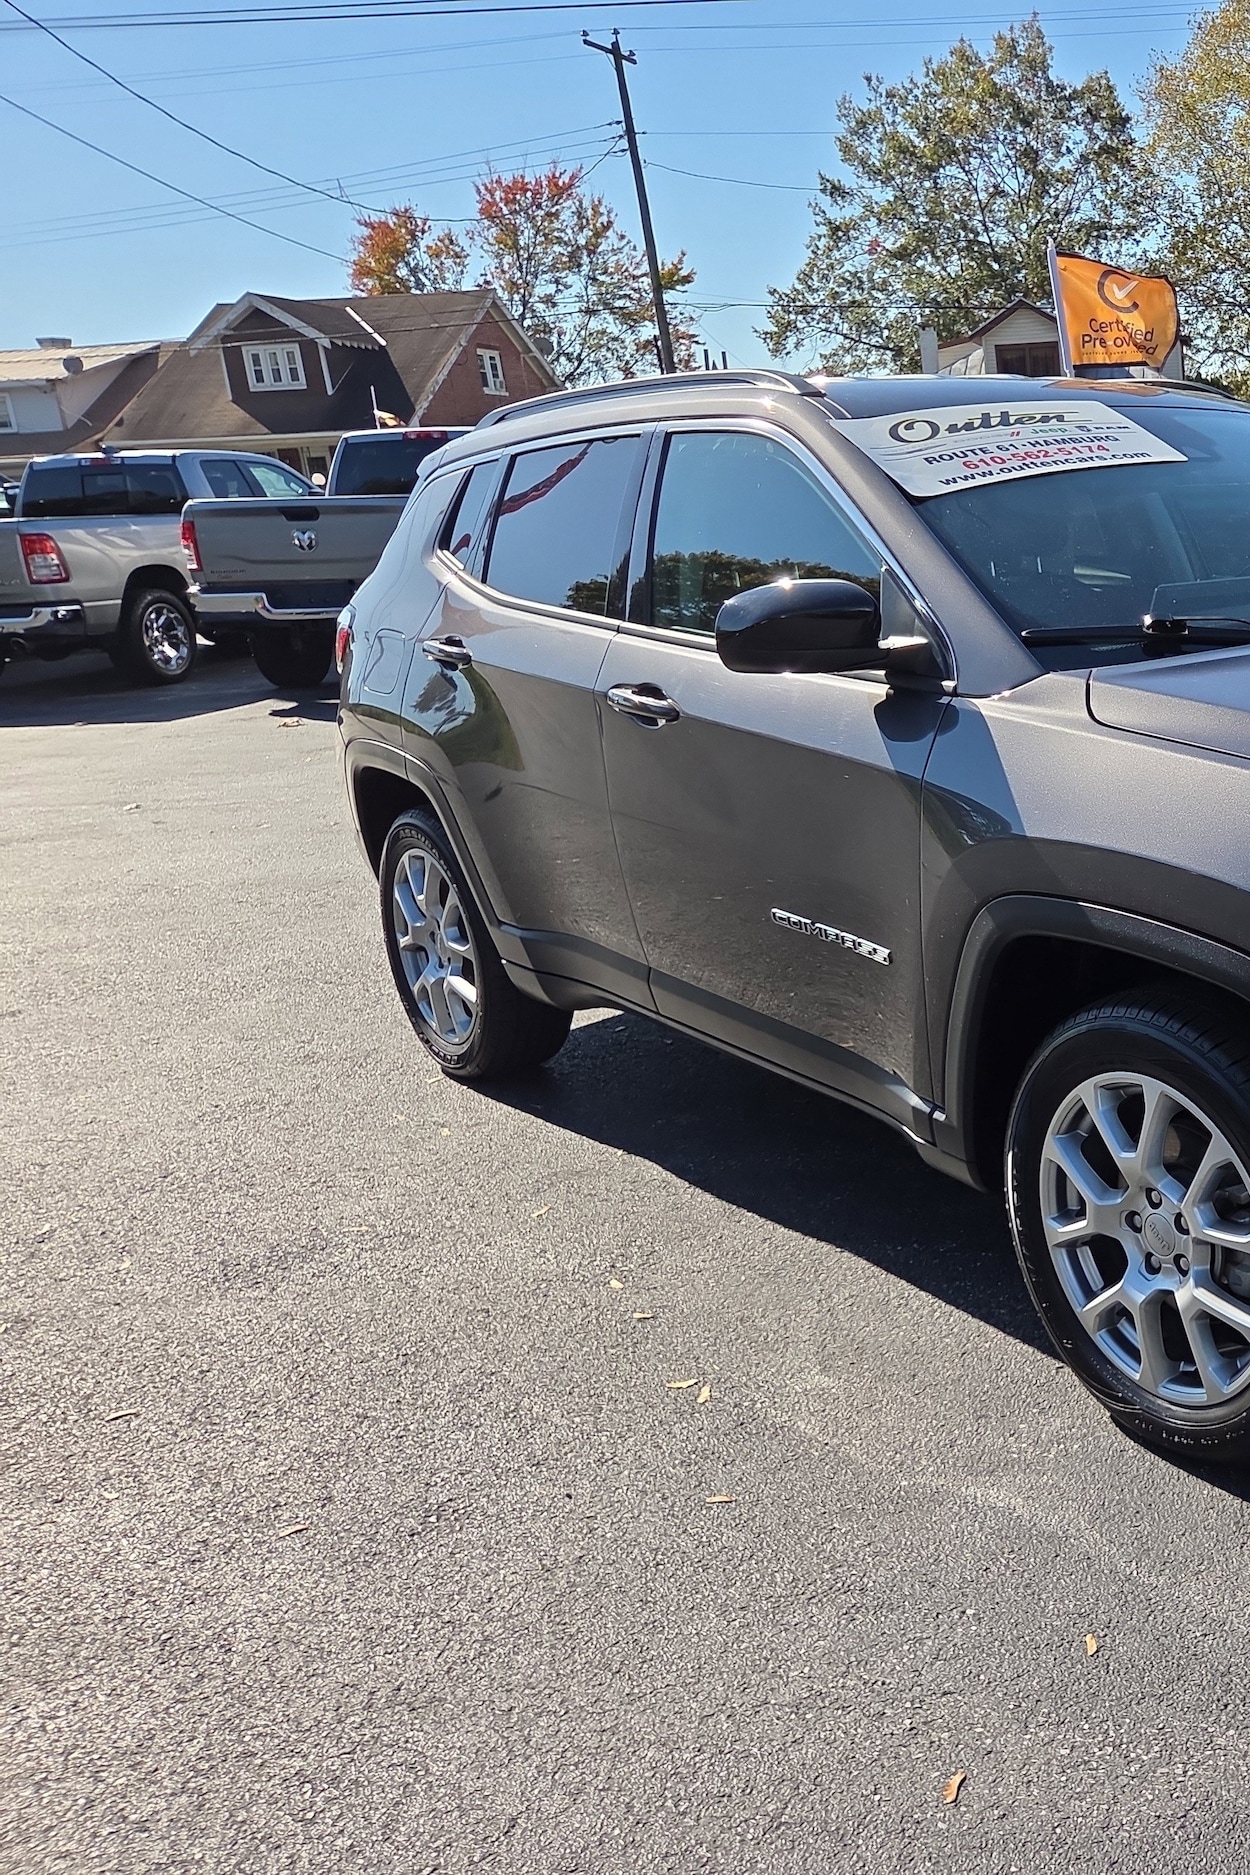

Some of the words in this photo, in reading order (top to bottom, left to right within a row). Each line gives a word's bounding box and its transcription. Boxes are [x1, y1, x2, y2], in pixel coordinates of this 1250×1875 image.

[888, 410, 1092, 443] Outten
[922, 446, 994, 465] ROUTE
[937, 451, 1152, 486] www.outtencars.com
[962, 444, 1110, 470] 610-562-5174
